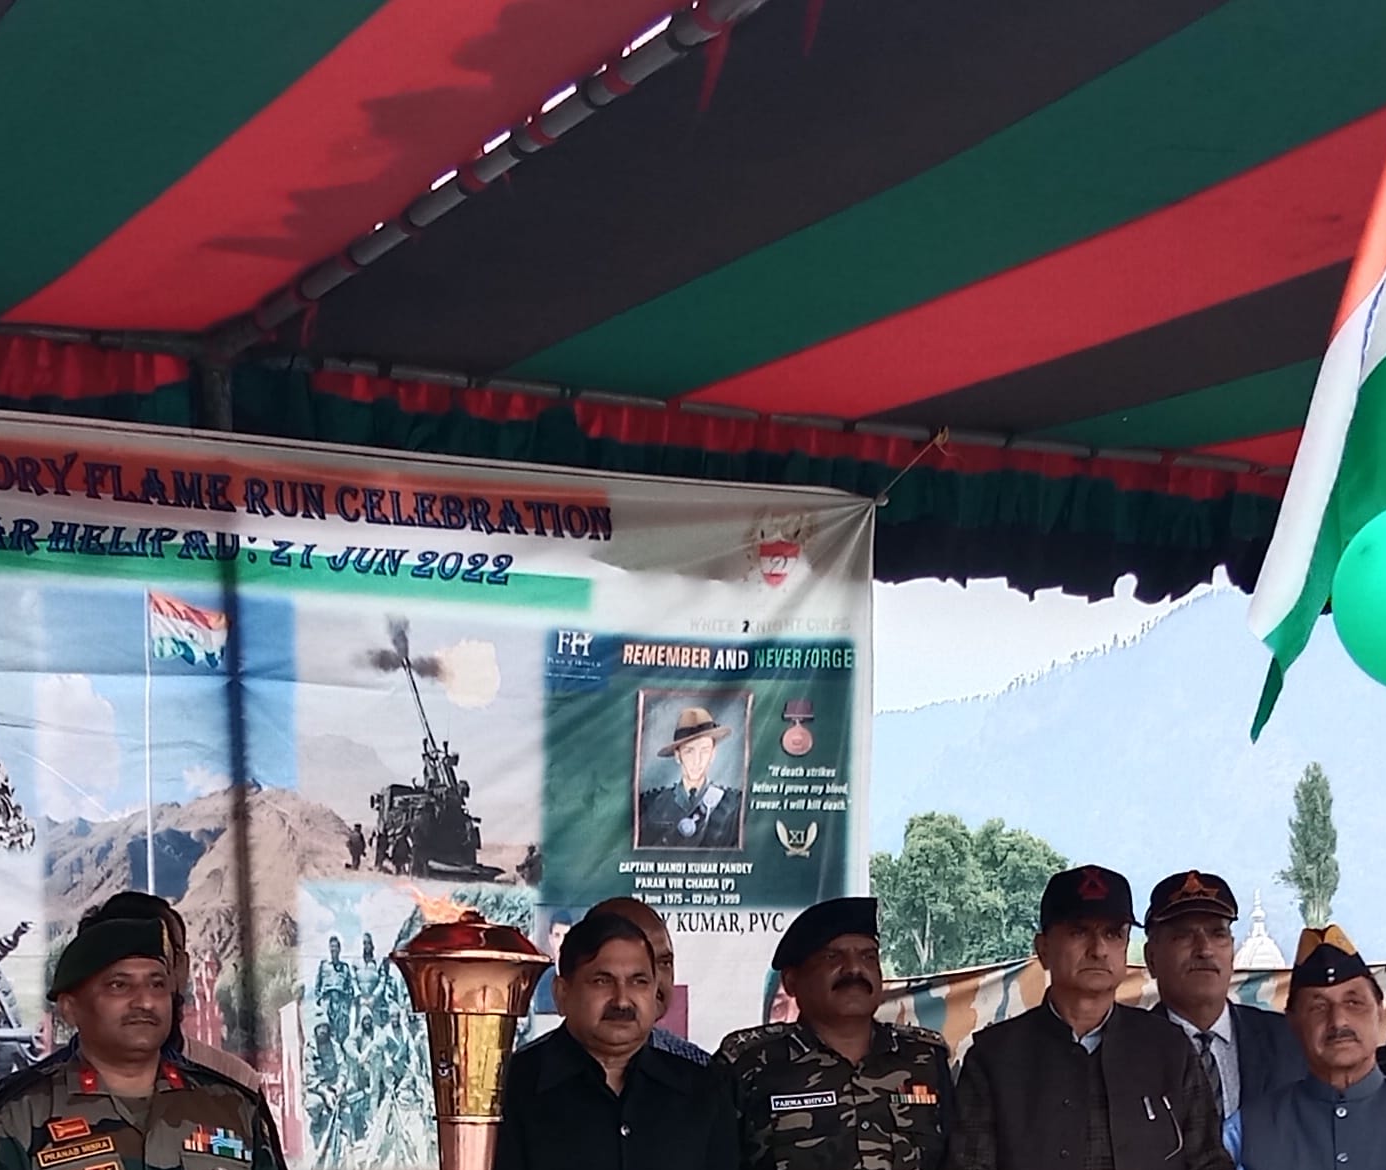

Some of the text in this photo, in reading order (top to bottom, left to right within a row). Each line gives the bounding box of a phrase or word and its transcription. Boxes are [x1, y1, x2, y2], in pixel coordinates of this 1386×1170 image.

[85, 462, 235, 512] FLAME
[245, 478, 326, 520] RUN
[335, 485, 611, 541] CELEBRATION
[327, 546, 410, 578] JUN
[412, 550, 514, 586] 2022
[622, 644, 711, 669] REMEMBER
[714, 649, 749, 670] AND
[754, 648, 802, 669] NEVER
[780, 766, 805, 777] death
[806, 766, 836, 778] strikes
[784, 784, 809, 796] prove
[810, 785, 824, 796] my
[789, 799, 805, 810] will
[806, 799, 822, 810] kill
[789, 830, 805, 844] XI
[619, 862, 753, 874] CAPTAIN MANOJ KUMAR PANDEY
[635, 877, 666, 889] PARAM
[668, 878, 683, 889] VIR
[685, 878, 719, 889] CHAKRA
[644, 893, 662, 905] June
[664, 893, 682, 904] 1975
[703, 894, 717, 906] July
[720, 894, 740, 905] 1999
[677, 912, 744, 935] KUMAR,
[749, 912, 785, 932] PVC
